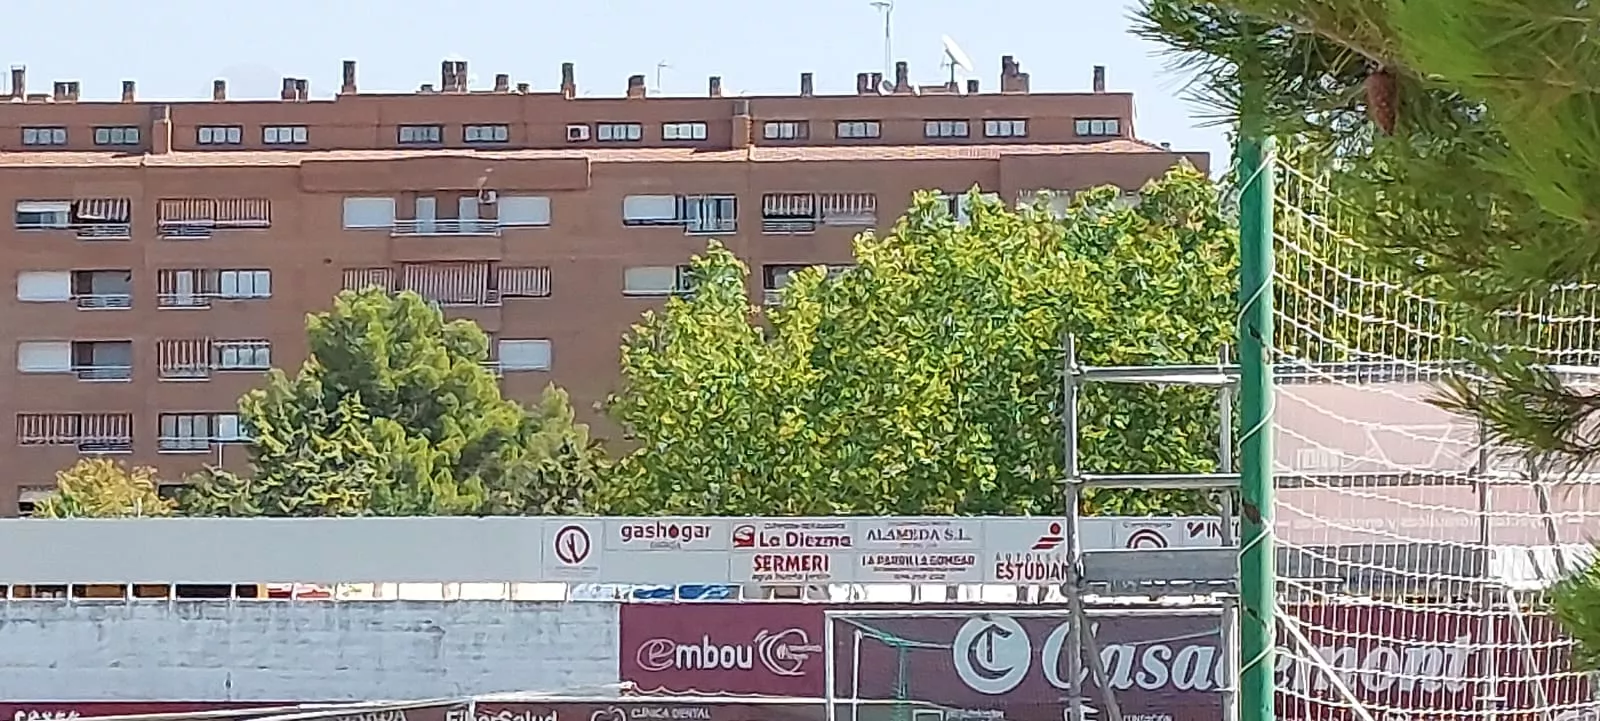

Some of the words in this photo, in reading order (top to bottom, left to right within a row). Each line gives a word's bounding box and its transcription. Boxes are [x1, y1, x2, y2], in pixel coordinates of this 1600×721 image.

[621, 521, 711, 542] gashogar
[760, 532, 780, 547] La
[786, 532, 852, 547] Diezma
[867, 528, 940, 541] ALAMEDA
[753, 555, 829, 572] SERMERI
[636, 634, 752, 672] embou
